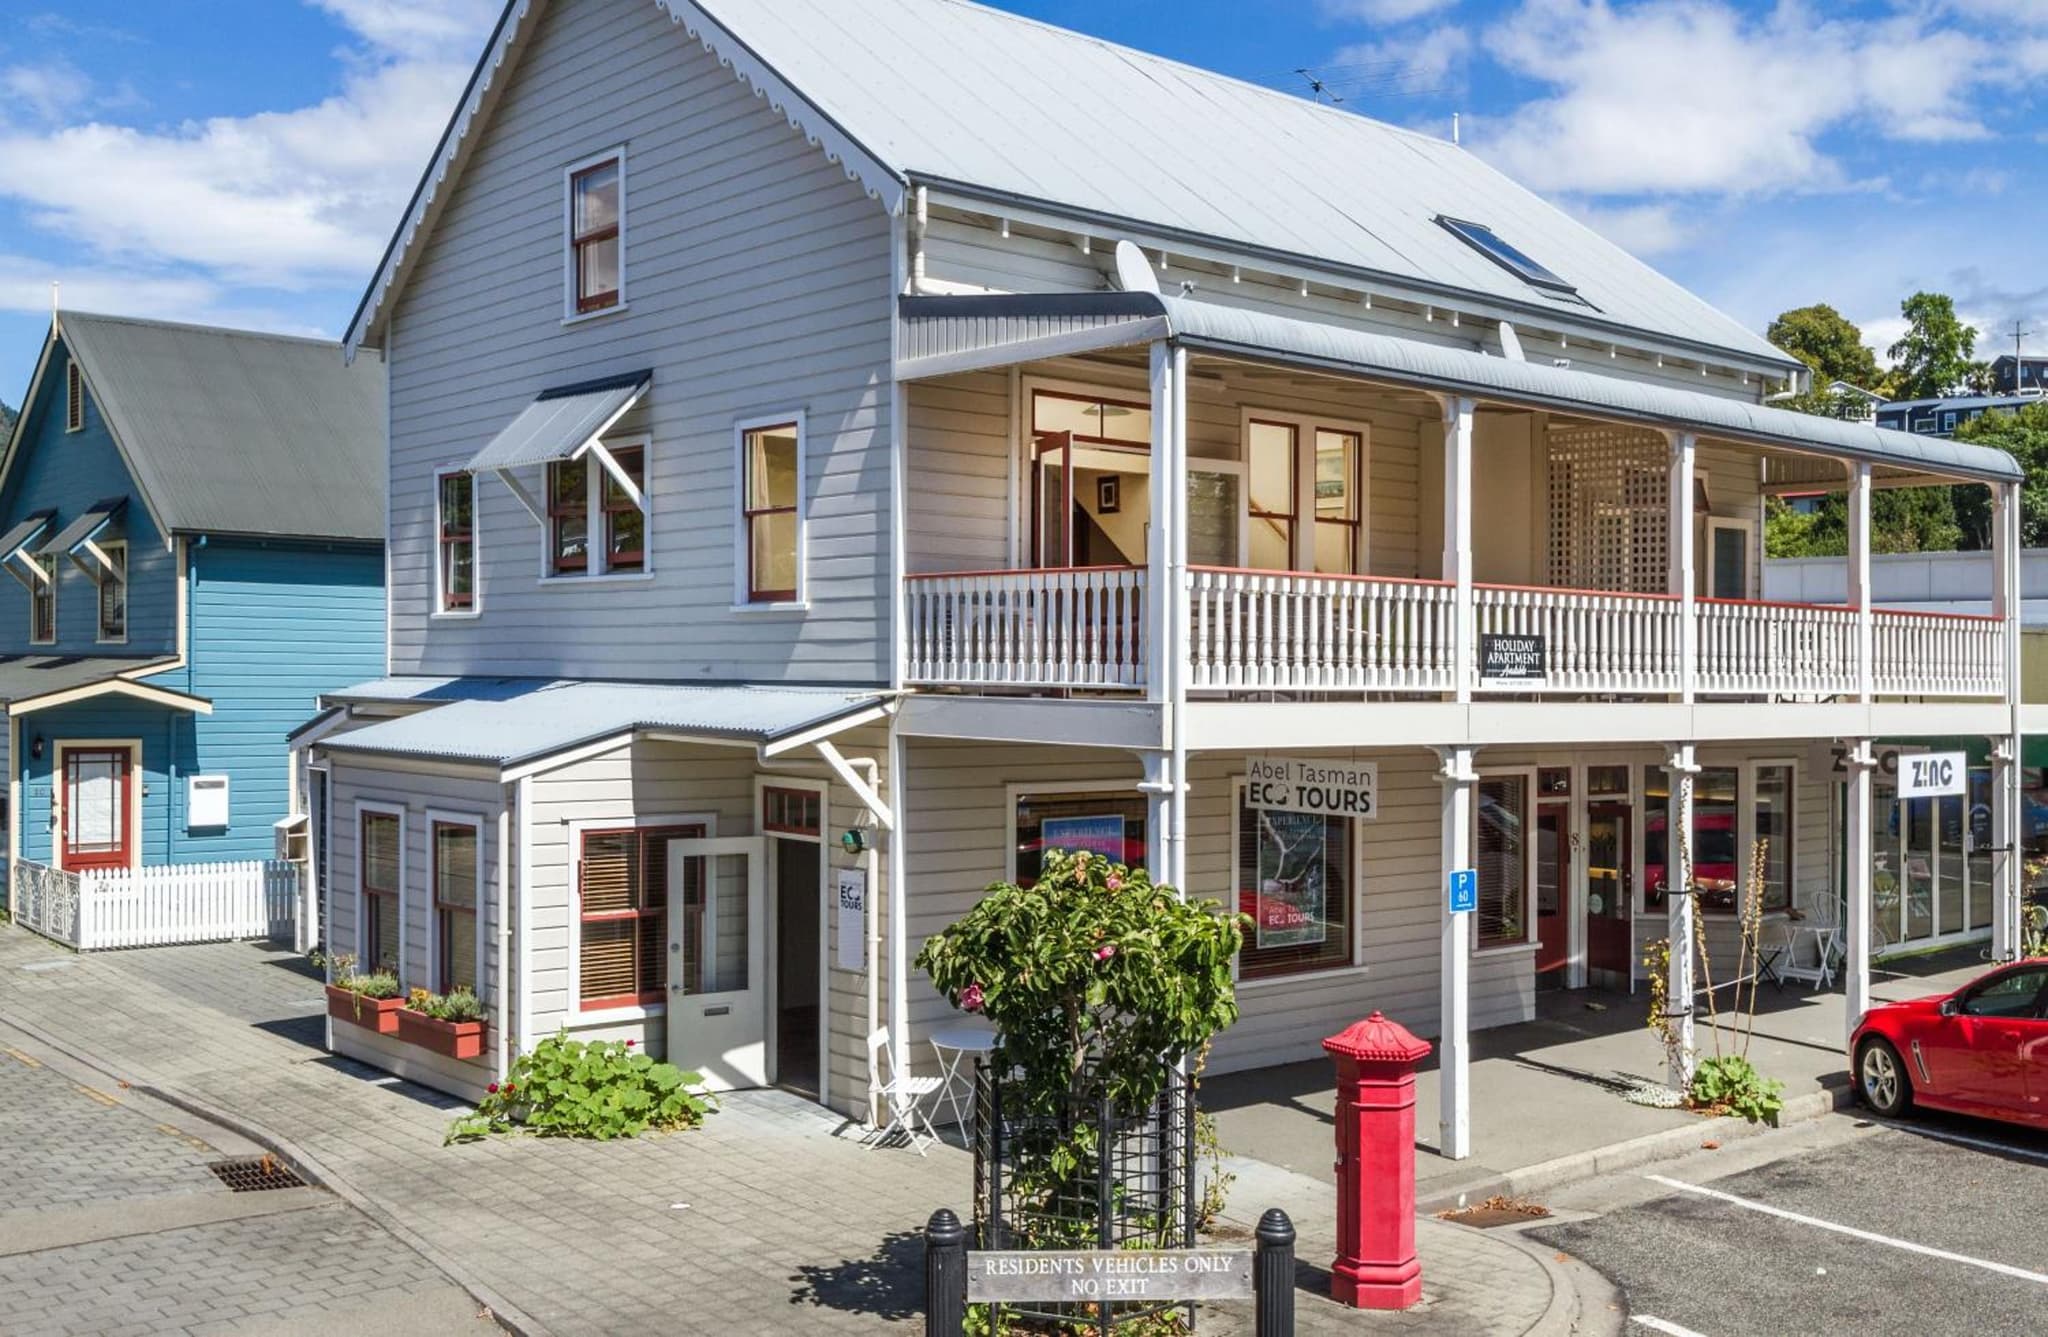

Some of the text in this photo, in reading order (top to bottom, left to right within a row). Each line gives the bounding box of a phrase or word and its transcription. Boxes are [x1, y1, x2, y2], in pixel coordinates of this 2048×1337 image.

[1494, 639, 1534, 652] HOLIDAY
[1487, 651, 1540, 665] APARTMENT
[1250, 760, 1371, 786] Abel Tasman
[1296, 786, 1371, 813] TOURS
[1459, 873, 1468, 889] P
[841, 899, 862, 911] TOURS
[1287, 912, 1315, 924] TOURS
[985, 1256, 1234, 1275] RESIDENTS VEHICLES ONLY
[1071, 1278, 1150, 1295] NO EXIT
